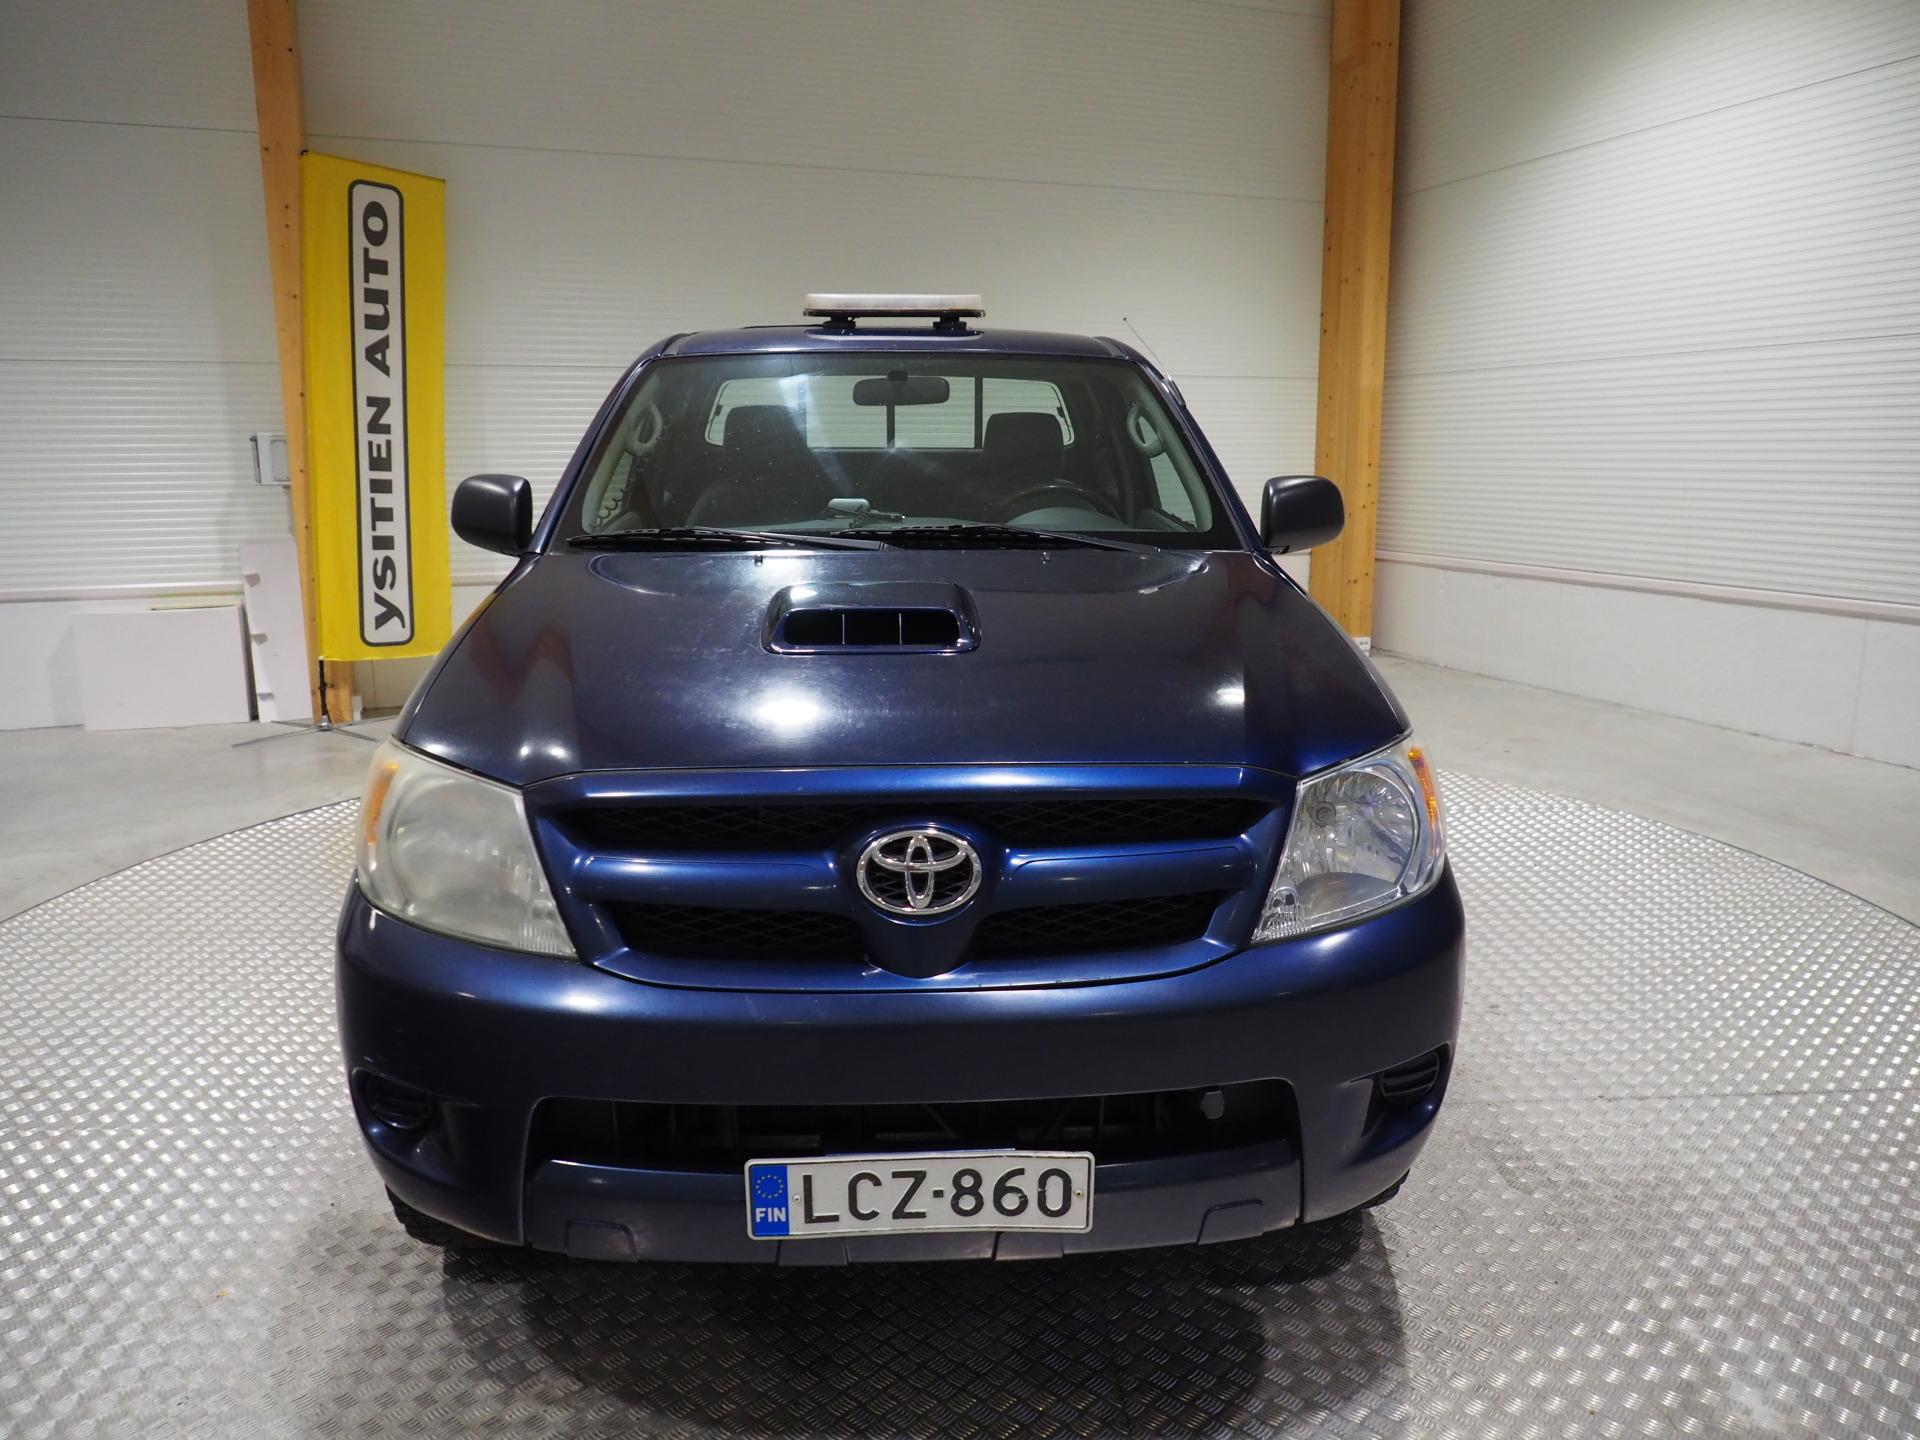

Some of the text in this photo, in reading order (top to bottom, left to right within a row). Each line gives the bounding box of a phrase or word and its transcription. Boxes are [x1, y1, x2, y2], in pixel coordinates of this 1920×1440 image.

[362, 200, 392, 378] AUTO
[755, 1208, 787, 1222] FIN
[803, 1168, 1073, 1223] LCZ-860
